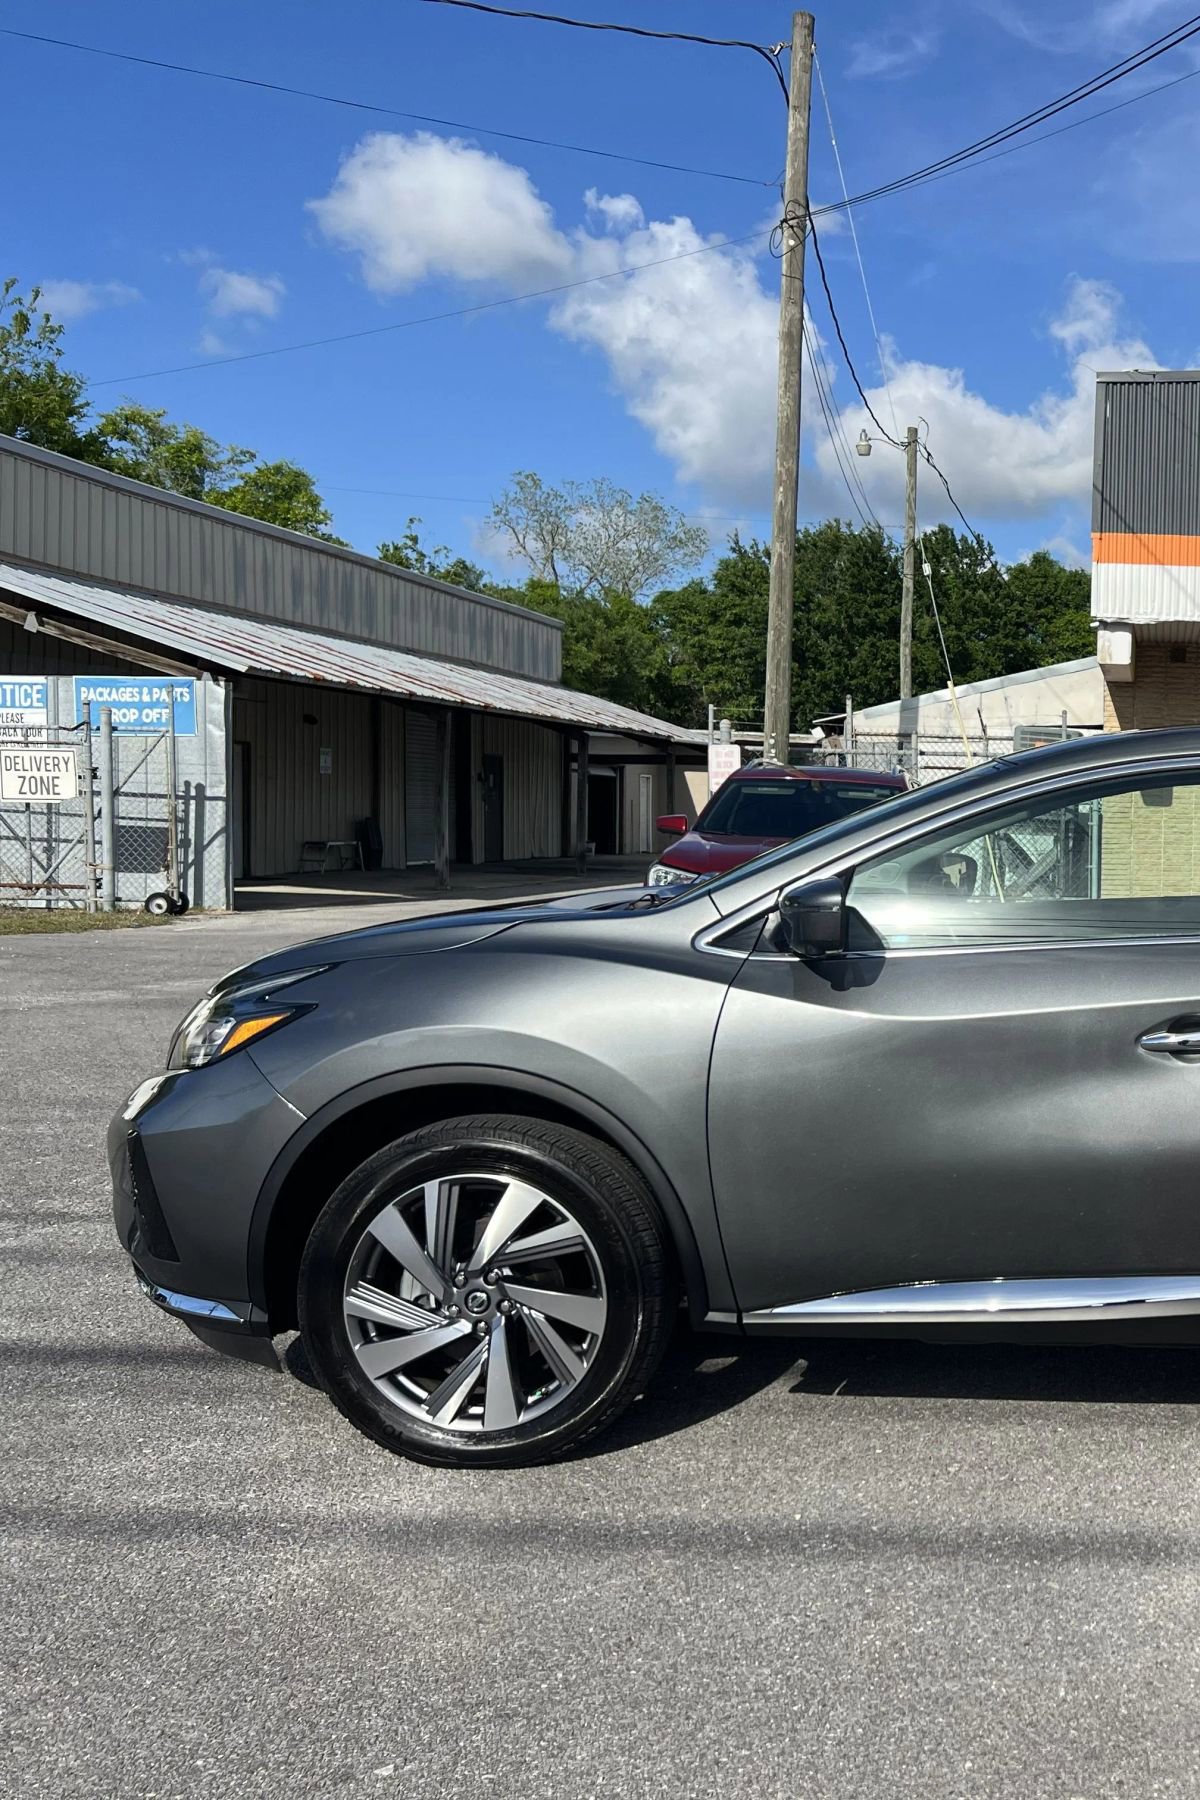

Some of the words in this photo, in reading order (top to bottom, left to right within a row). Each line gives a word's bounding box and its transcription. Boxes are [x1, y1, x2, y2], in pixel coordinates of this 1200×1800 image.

[0, 684, 44, 707] TICE
[81, 687, 140, 702] PACKAGES
[142, 687, 150, 702] &
[111, 708, 139, 723] ROP
[142, 708, 169, 723] OFF
[4, 755, 70, 773] DELIVERY
[17, 775, 61, 796] ZONE
